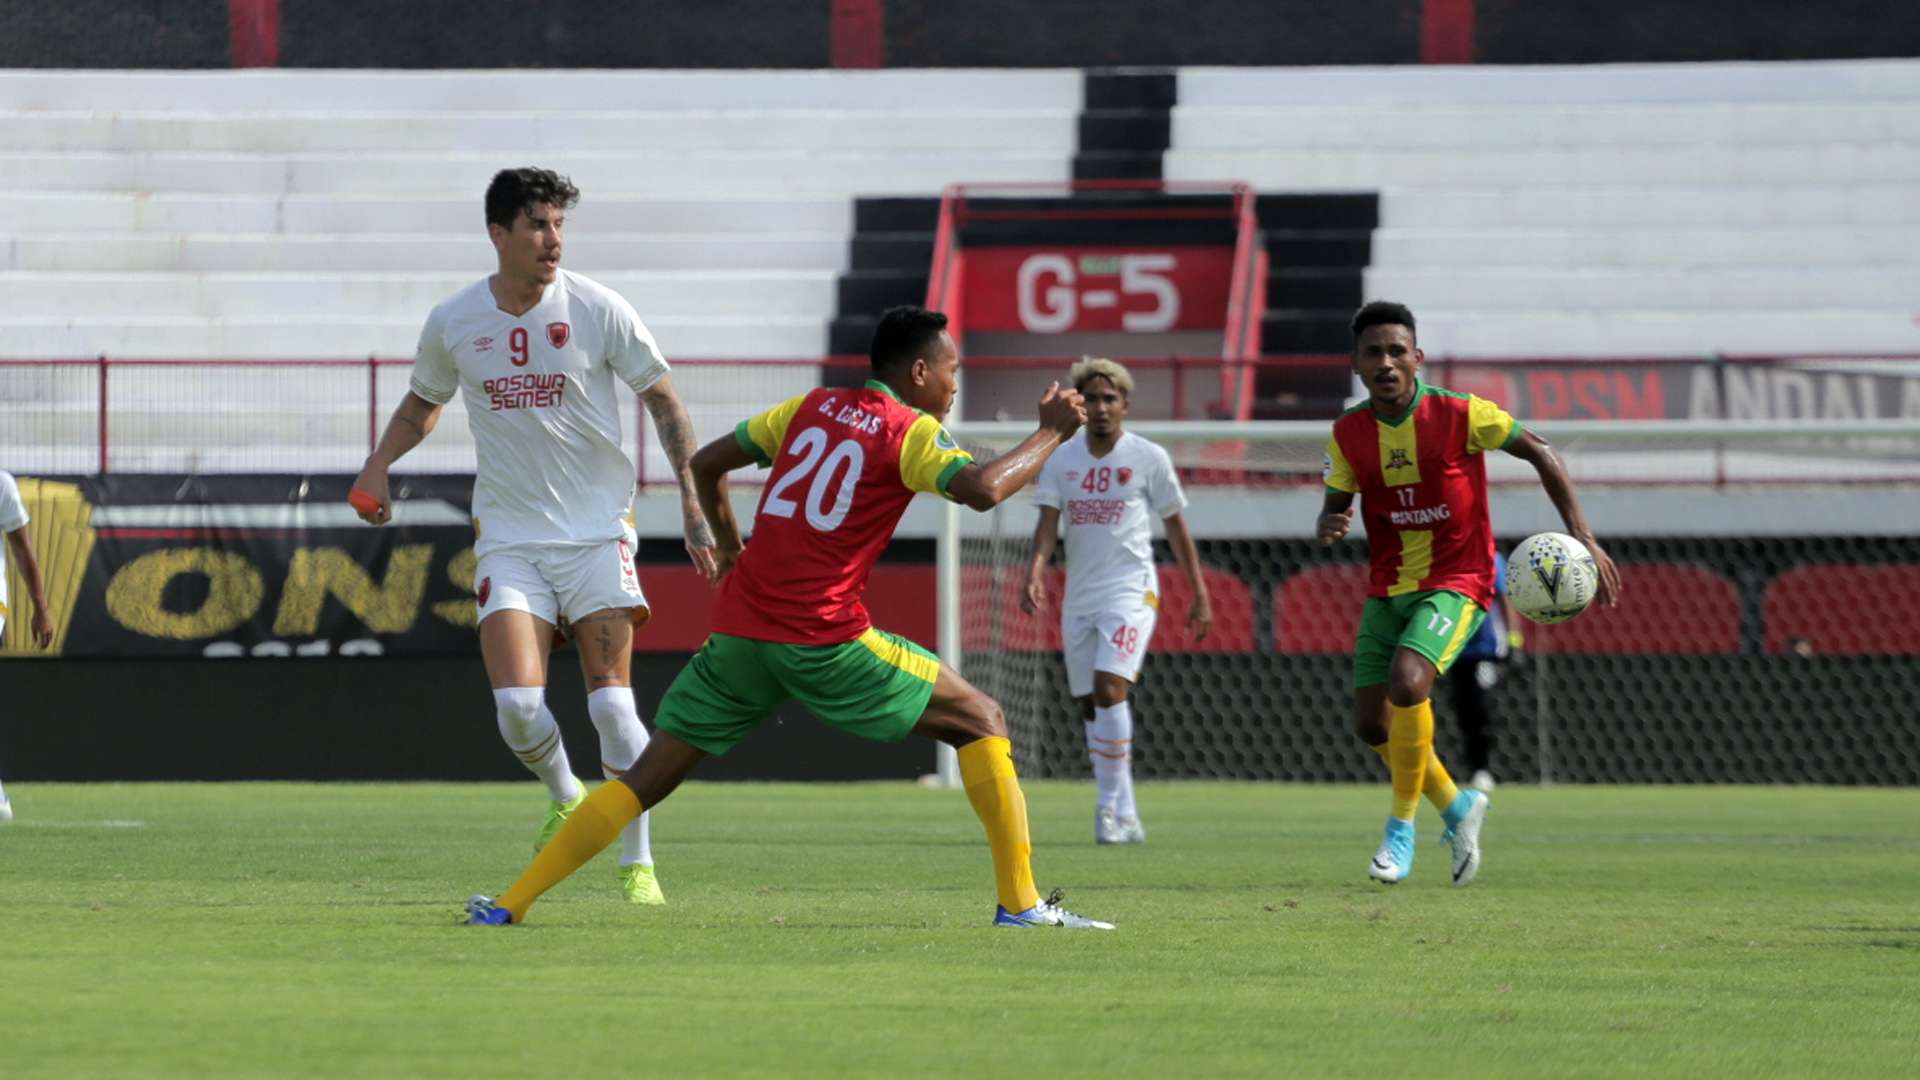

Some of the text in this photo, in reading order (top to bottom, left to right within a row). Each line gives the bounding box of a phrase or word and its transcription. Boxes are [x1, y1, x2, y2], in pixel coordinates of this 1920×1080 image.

[1017, 254, 1180, 333] G-5
[510, 327, 529, 367] 9
[483, 374, 567, 394] BOSOWA
[1527, 371, 1664, 420] PSM
[491, 390, 563, 411] SEMEN
[761, 426, 865, 532] 20
[1081, 466, 1111, 493] 48
[1397, 487, 1415, 507] 17
[1426, 612, 1453, 637] 17
[1111, 624, 1138, 655] 48
